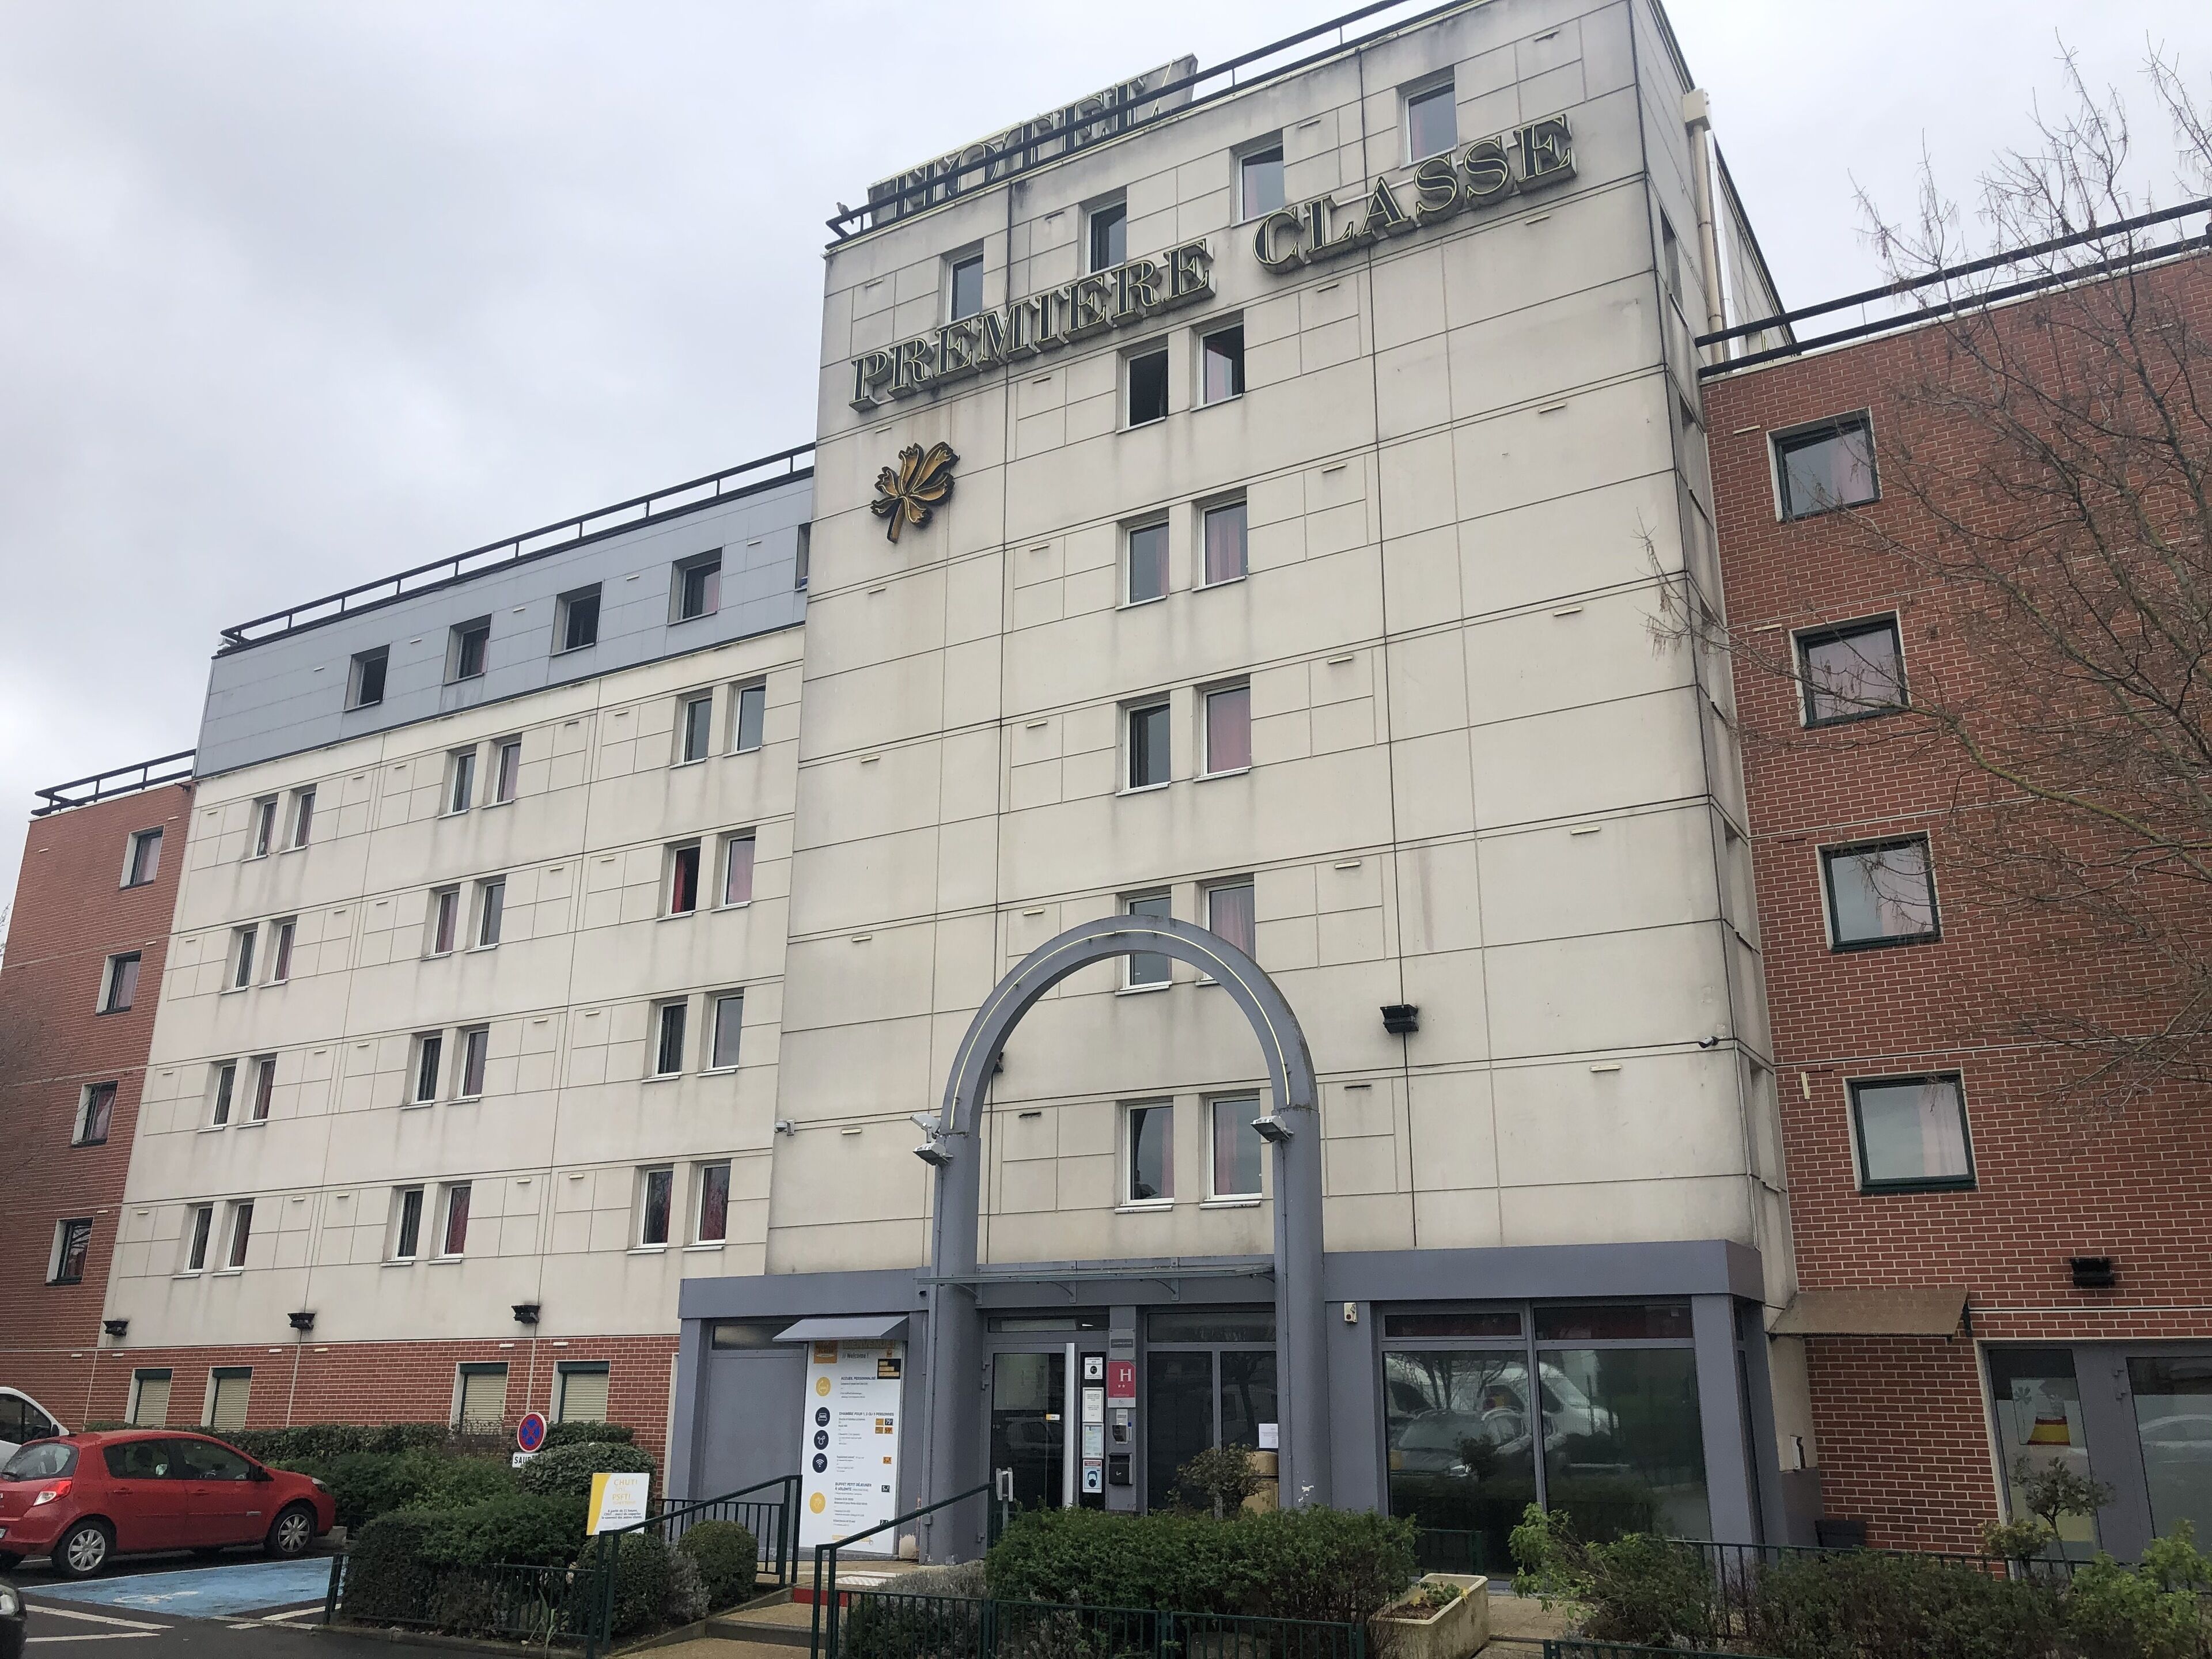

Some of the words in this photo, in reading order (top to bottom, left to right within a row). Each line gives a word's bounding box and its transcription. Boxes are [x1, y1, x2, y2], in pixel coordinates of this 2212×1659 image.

[849, 238, 1214, 411] PREMIERE
[1252, 114, 1575, 272] CLASSE
[1120, 1368, 1132, 1382] H
